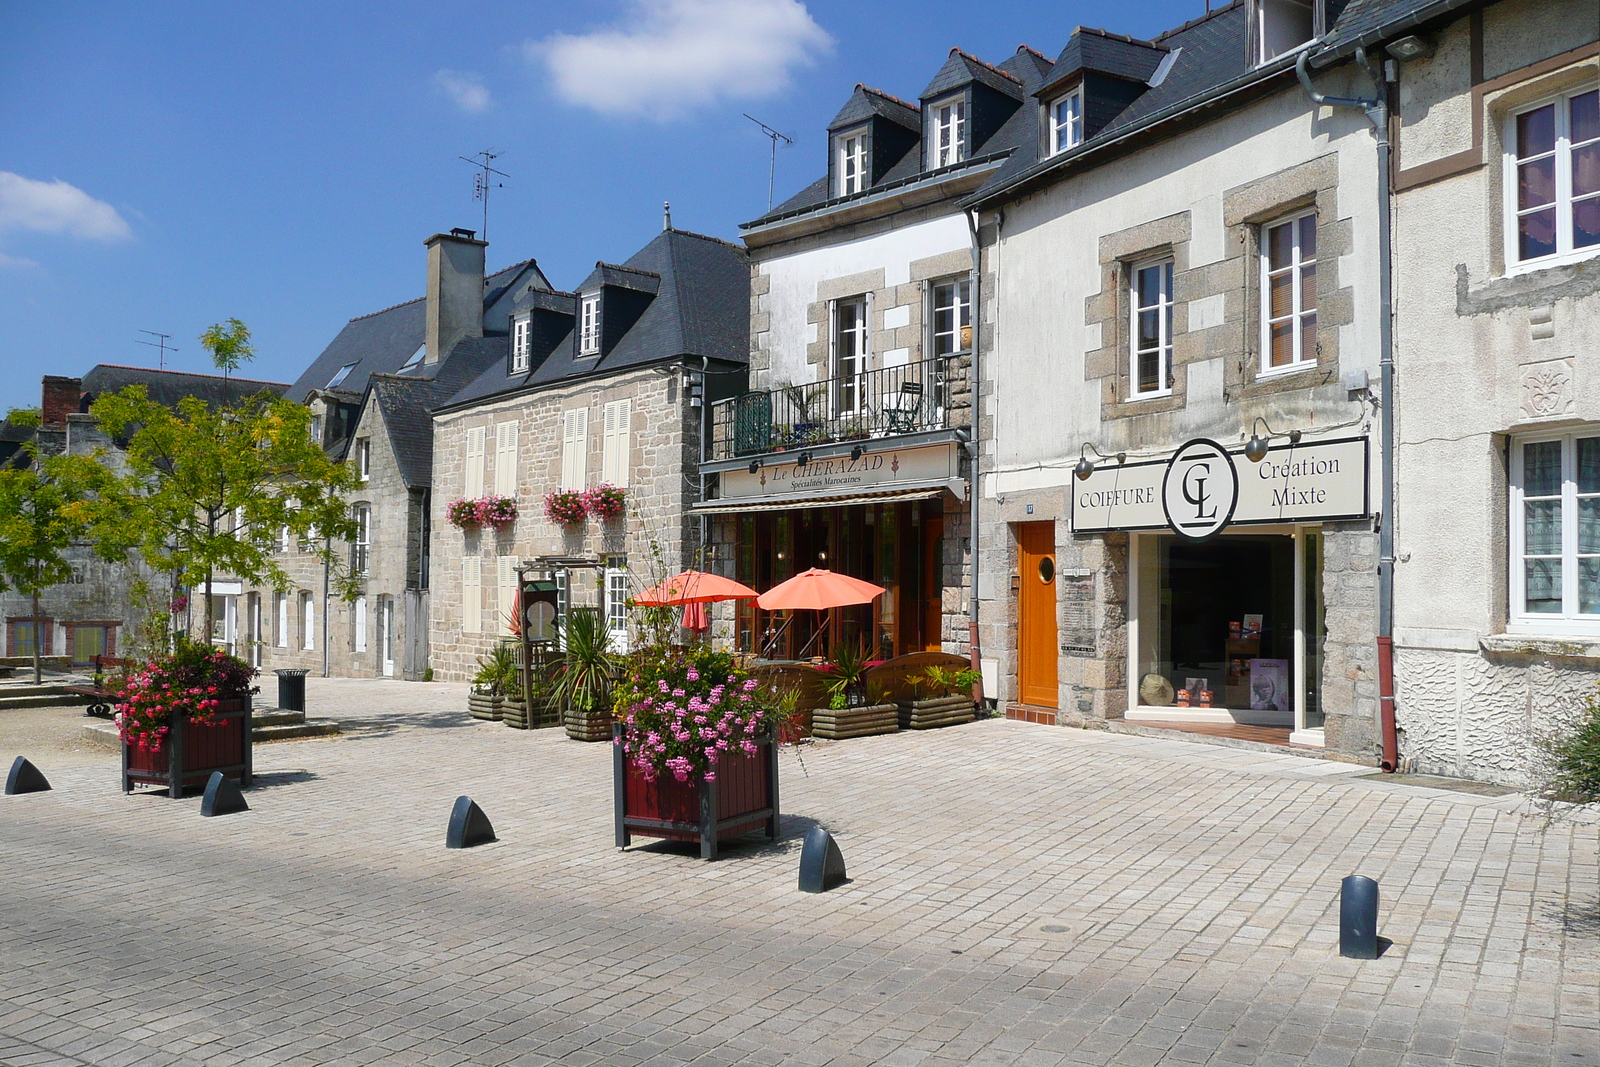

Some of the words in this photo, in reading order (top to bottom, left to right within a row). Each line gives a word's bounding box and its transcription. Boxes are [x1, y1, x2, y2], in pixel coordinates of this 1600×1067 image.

[773, 467, 787, 480] Le
[792, 455, 883, 479] CHERAZAD
[1259, 456, 1340, 480] Création
[791, 479, 822, 490] Spécialités
[824, 475, 861, 486] Marocaines
[1080, 486, 1154, 508] COIFFURE
[1271, 486, 1326, 506] Mixte
